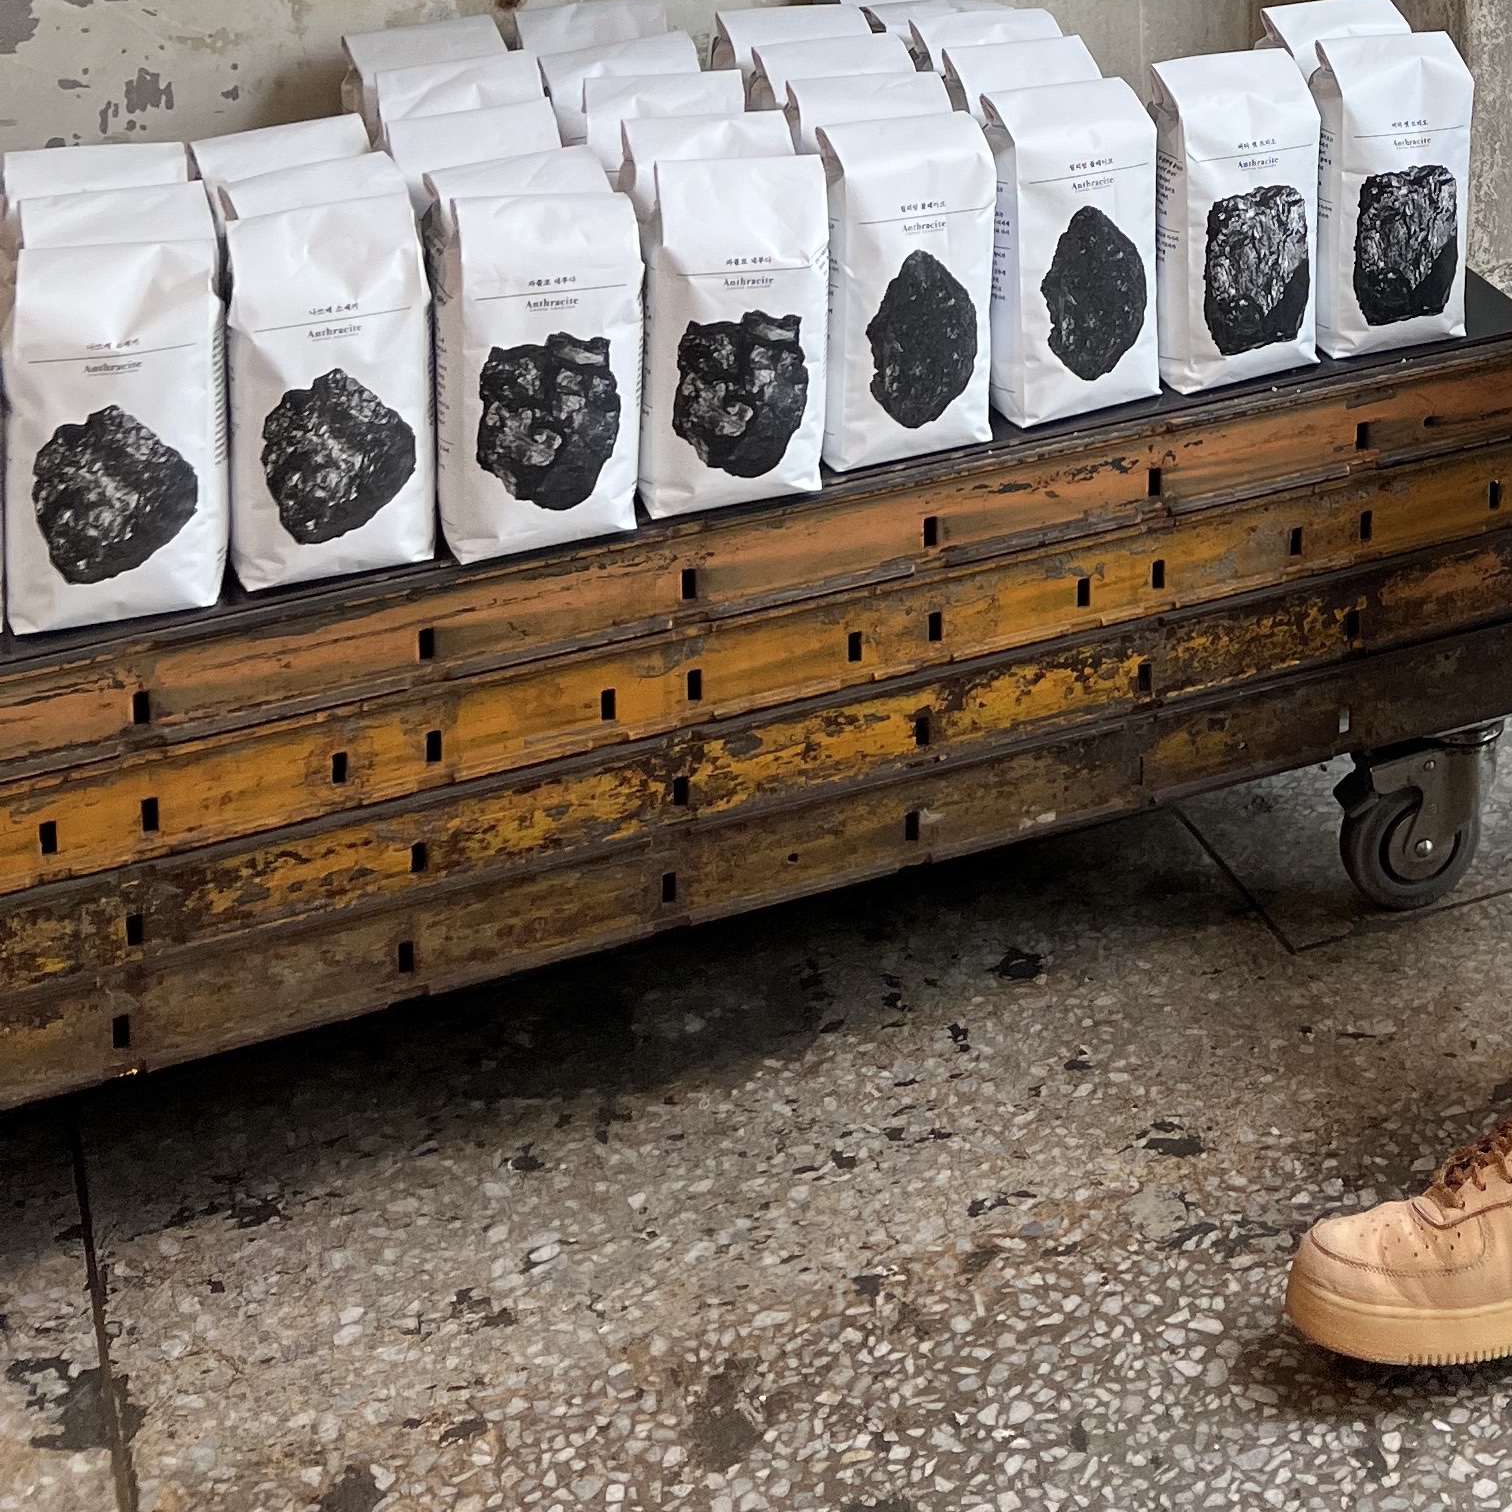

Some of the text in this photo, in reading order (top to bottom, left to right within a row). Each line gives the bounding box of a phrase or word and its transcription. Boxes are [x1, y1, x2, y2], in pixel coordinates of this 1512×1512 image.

[1238, 156, 1278, 168] Anthracite
[1072, 178, 1114, 190] Anthracite
[902, 220, 946, 232] Anthracite
[724, 276, 774, 286] Anthracite
[526, 296, 578, 308] Anthracite
[308, 324, 362, 338] Anthracite
[83, 360, 143, 374] Anthracite
